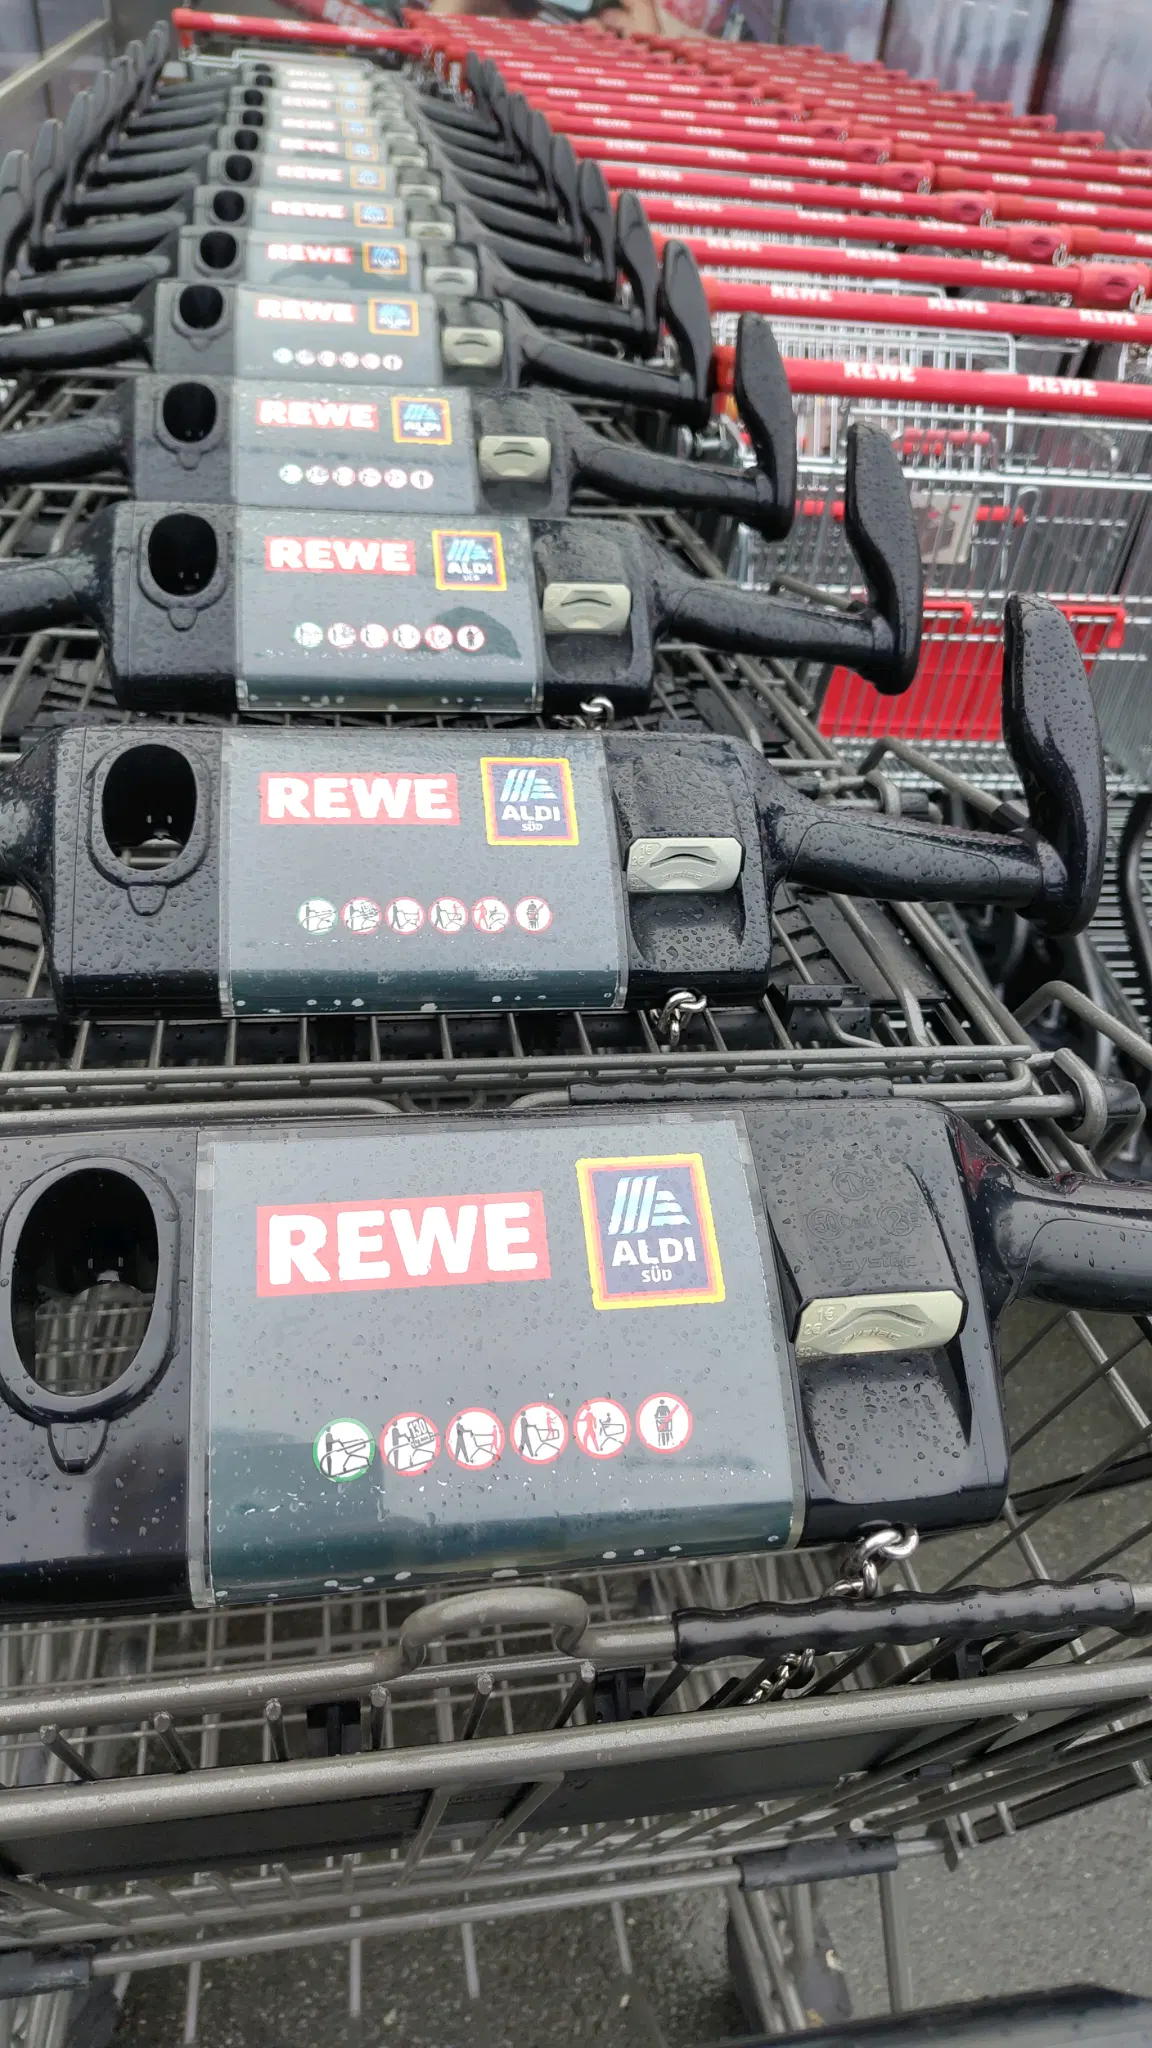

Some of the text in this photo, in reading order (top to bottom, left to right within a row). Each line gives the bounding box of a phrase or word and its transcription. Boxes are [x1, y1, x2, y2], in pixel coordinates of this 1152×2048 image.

[267, 244, 353, 265] REWE
[258, 299, 354, 322] REWE
[771, 285, 1139, 326] REWE REWE REWE
[844, 361, 1099, 397] REWE REWE
[259, 400, 374, 429] REWE
[269, 538, 411, 573] REWE
[447, 561, 494, 575] ALDI
[267, 777, 453, 820] REWE
[501, 803, 561, 822] ALDI
[521, 820, 544, 833] SÜD
[266, 1201, 541, 1286] REWE
[610, 1237, 698, 1267] ALDI
[641, 1265, 673, 1284] SÜD
[408, 1418, 428, 1438] 130
